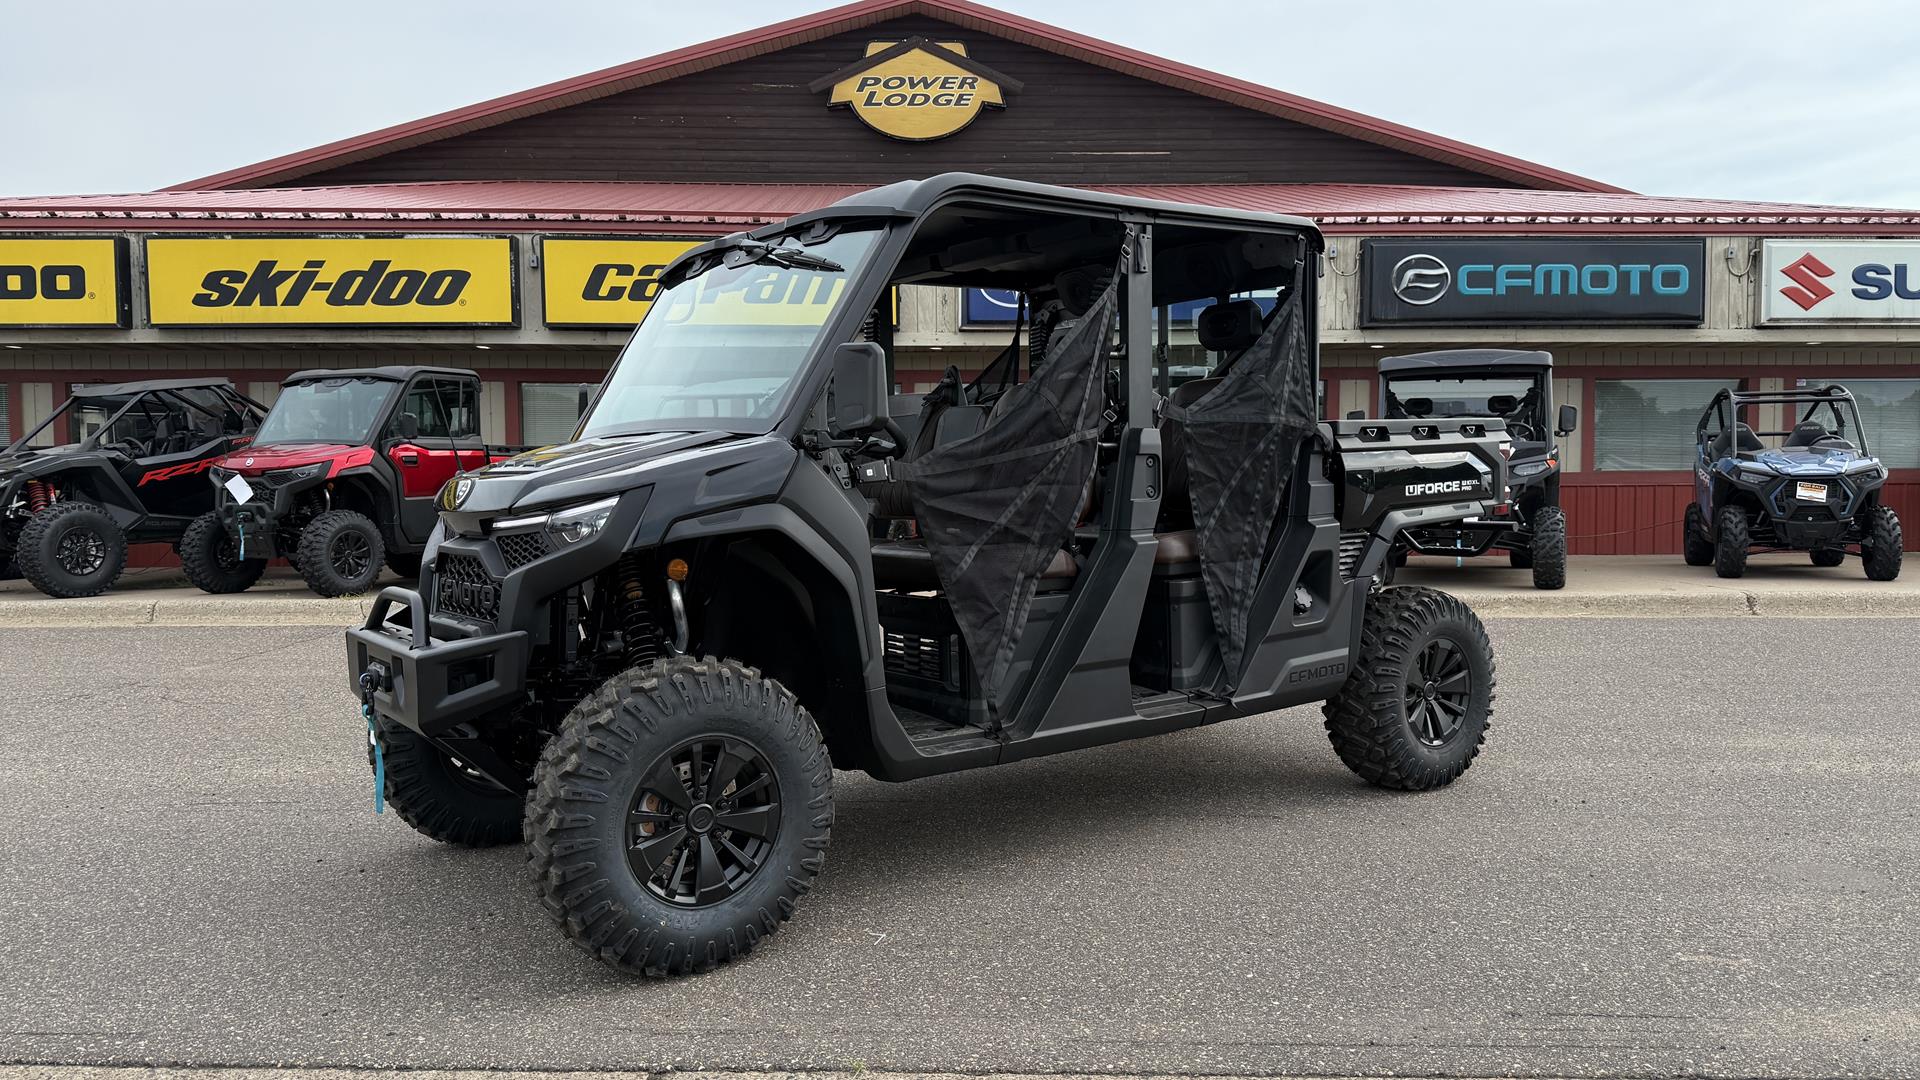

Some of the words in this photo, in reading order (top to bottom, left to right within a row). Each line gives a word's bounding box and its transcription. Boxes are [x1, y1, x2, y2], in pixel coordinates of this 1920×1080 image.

[856, 76, 979, 93] POWER
[863, 91, 974, 107] LODGE
[192, 260, 472, 307] ski-doo
[1457, 264, 1689, 296] CFMOTO
[1289, 662, 1346, 683] CFMOTO
